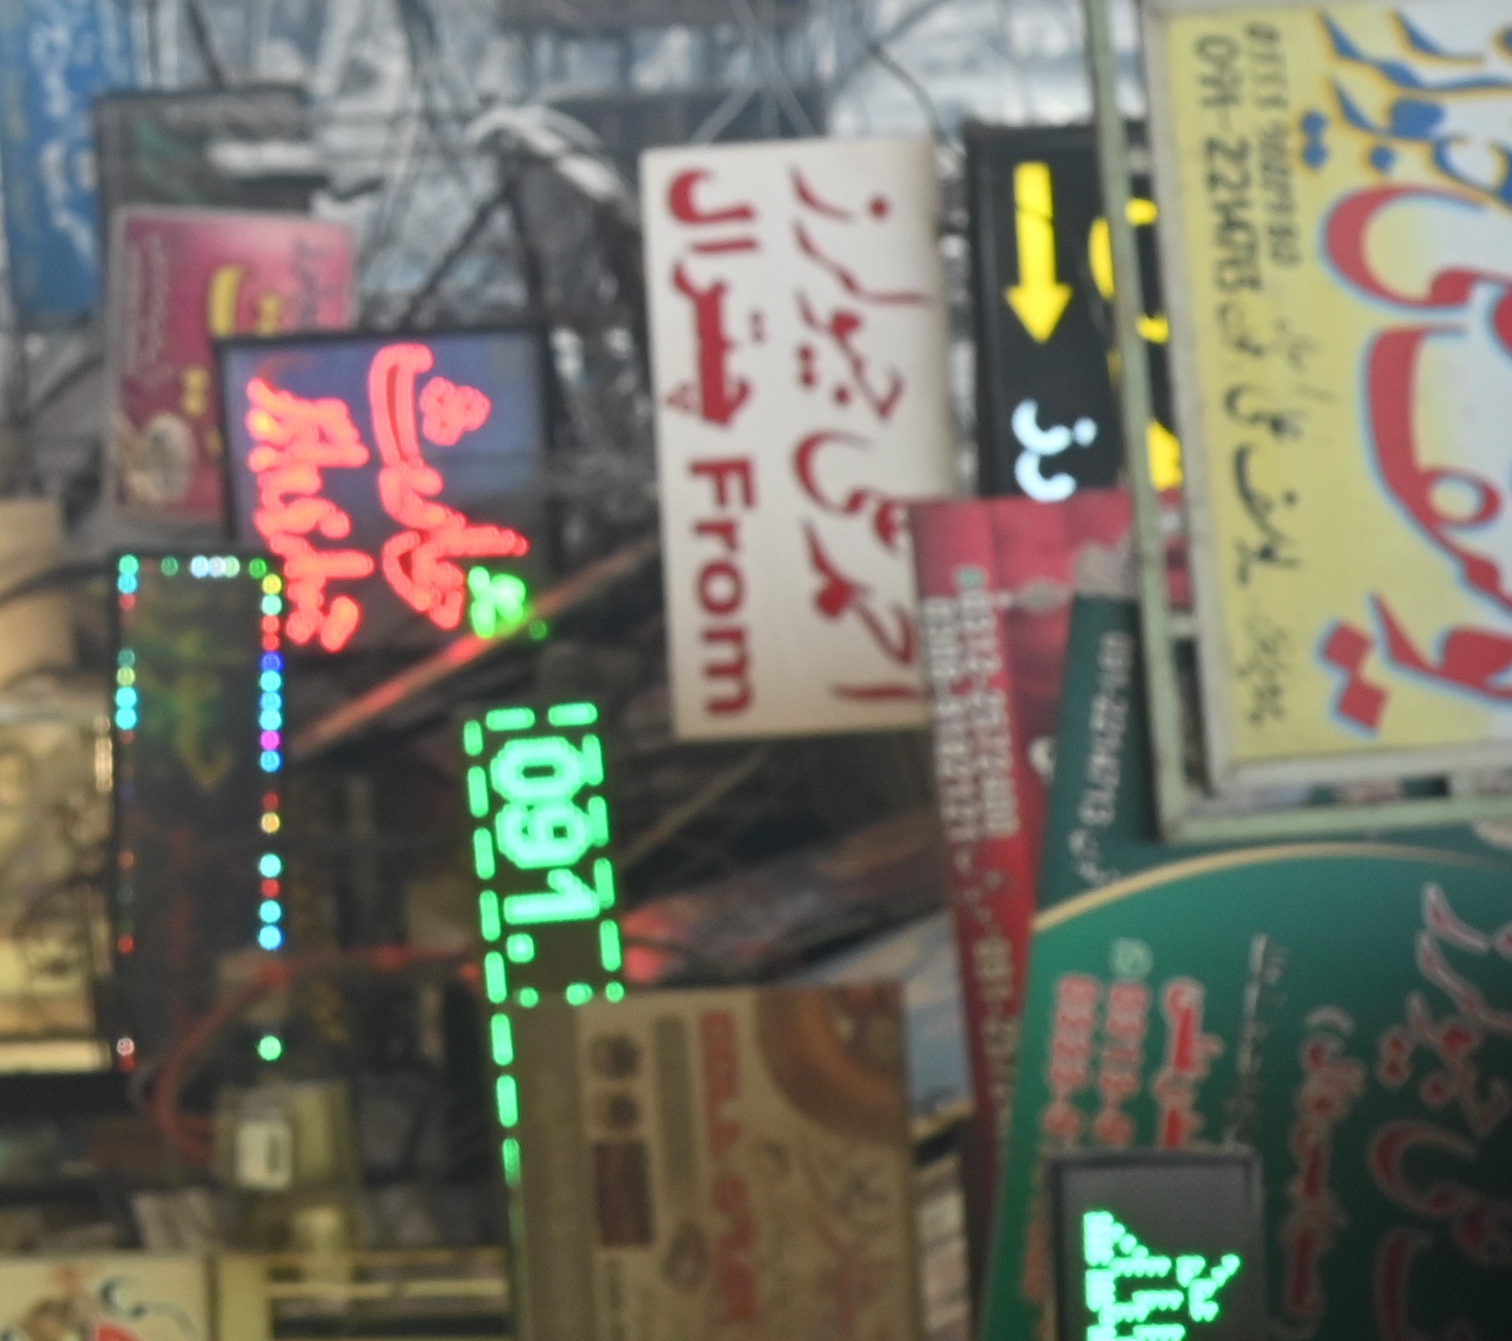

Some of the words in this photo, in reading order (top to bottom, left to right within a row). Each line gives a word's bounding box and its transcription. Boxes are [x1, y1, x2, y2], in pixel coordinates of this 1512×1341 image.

[665, 170, 764, 427] چترال
[788, 168, 939, 421] جیولرز
[368, 345, 529, 630] حارث
[690, 457, 757, 714] From
[801, 523, 928, 705] احمد
